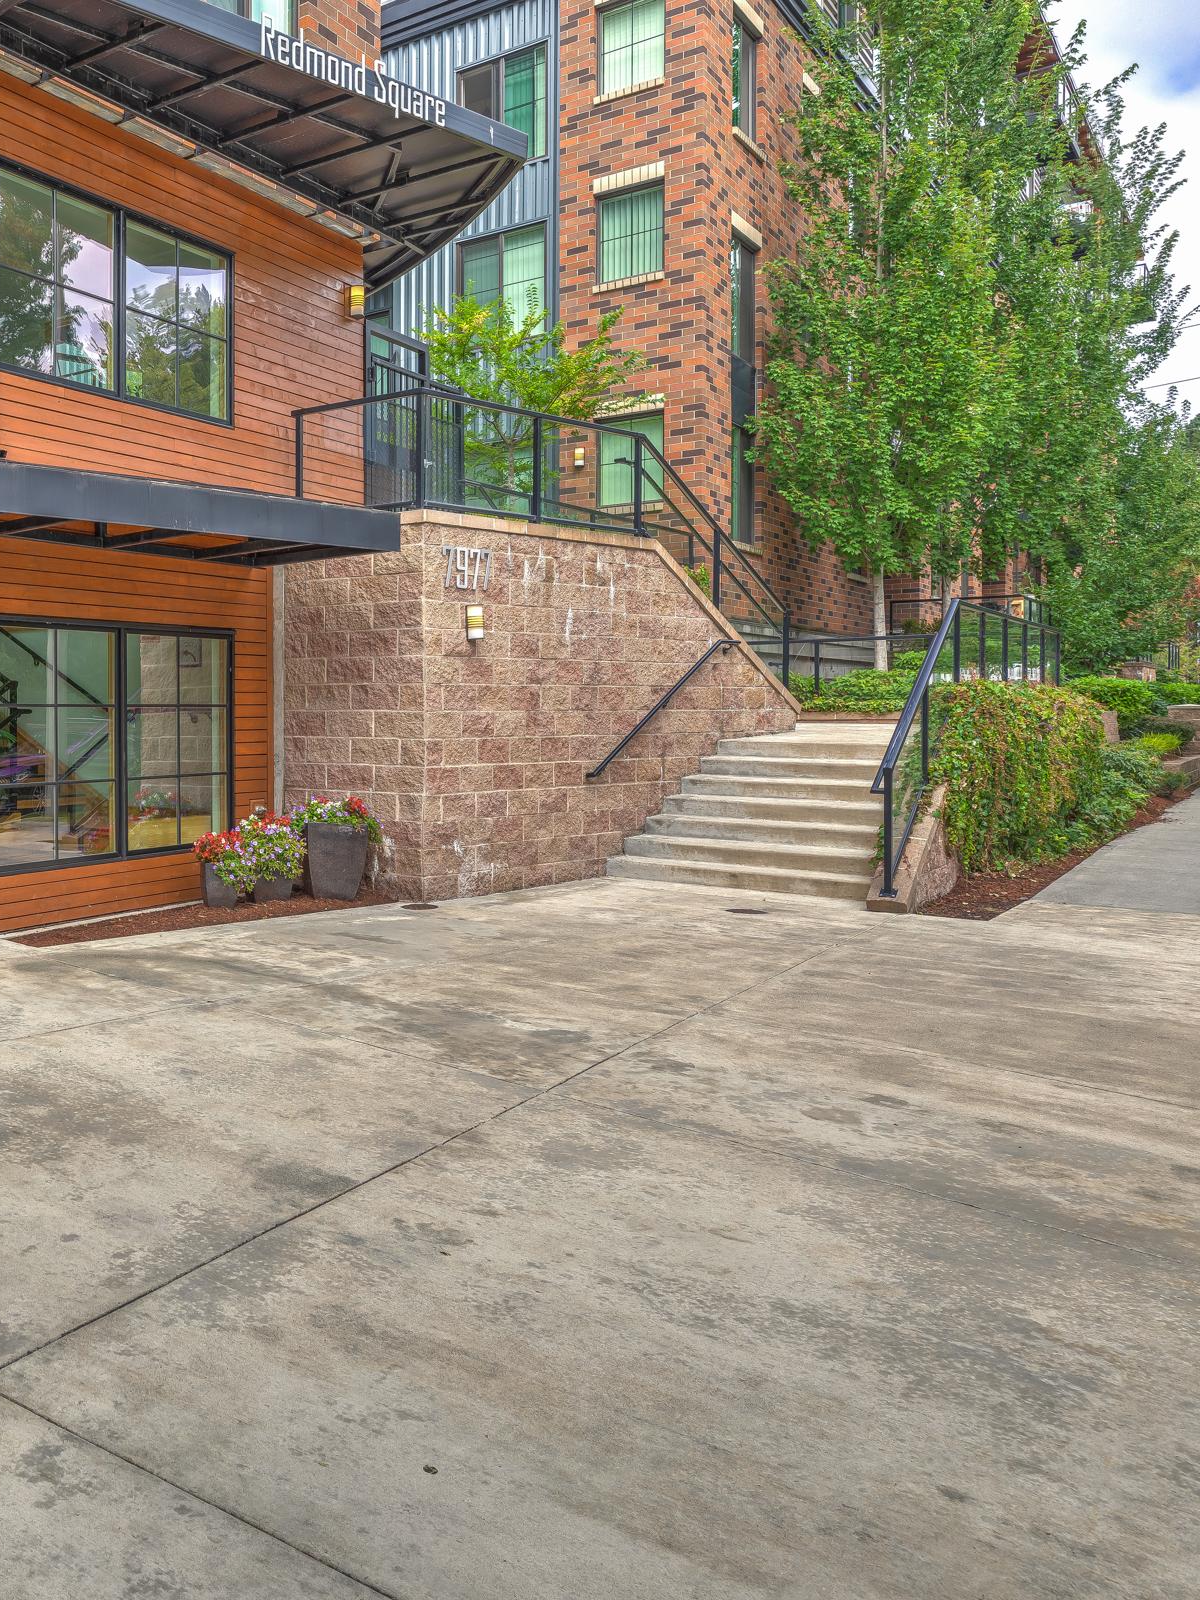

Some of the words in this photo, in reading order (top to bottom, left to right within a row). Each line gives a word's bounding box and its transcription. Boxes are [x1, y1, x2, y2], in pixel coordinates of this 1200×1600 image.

[261, 12, 366, 95] Redmond
[373, 59, 446, 127] Square
[442, 544, 492, 591] 7977
